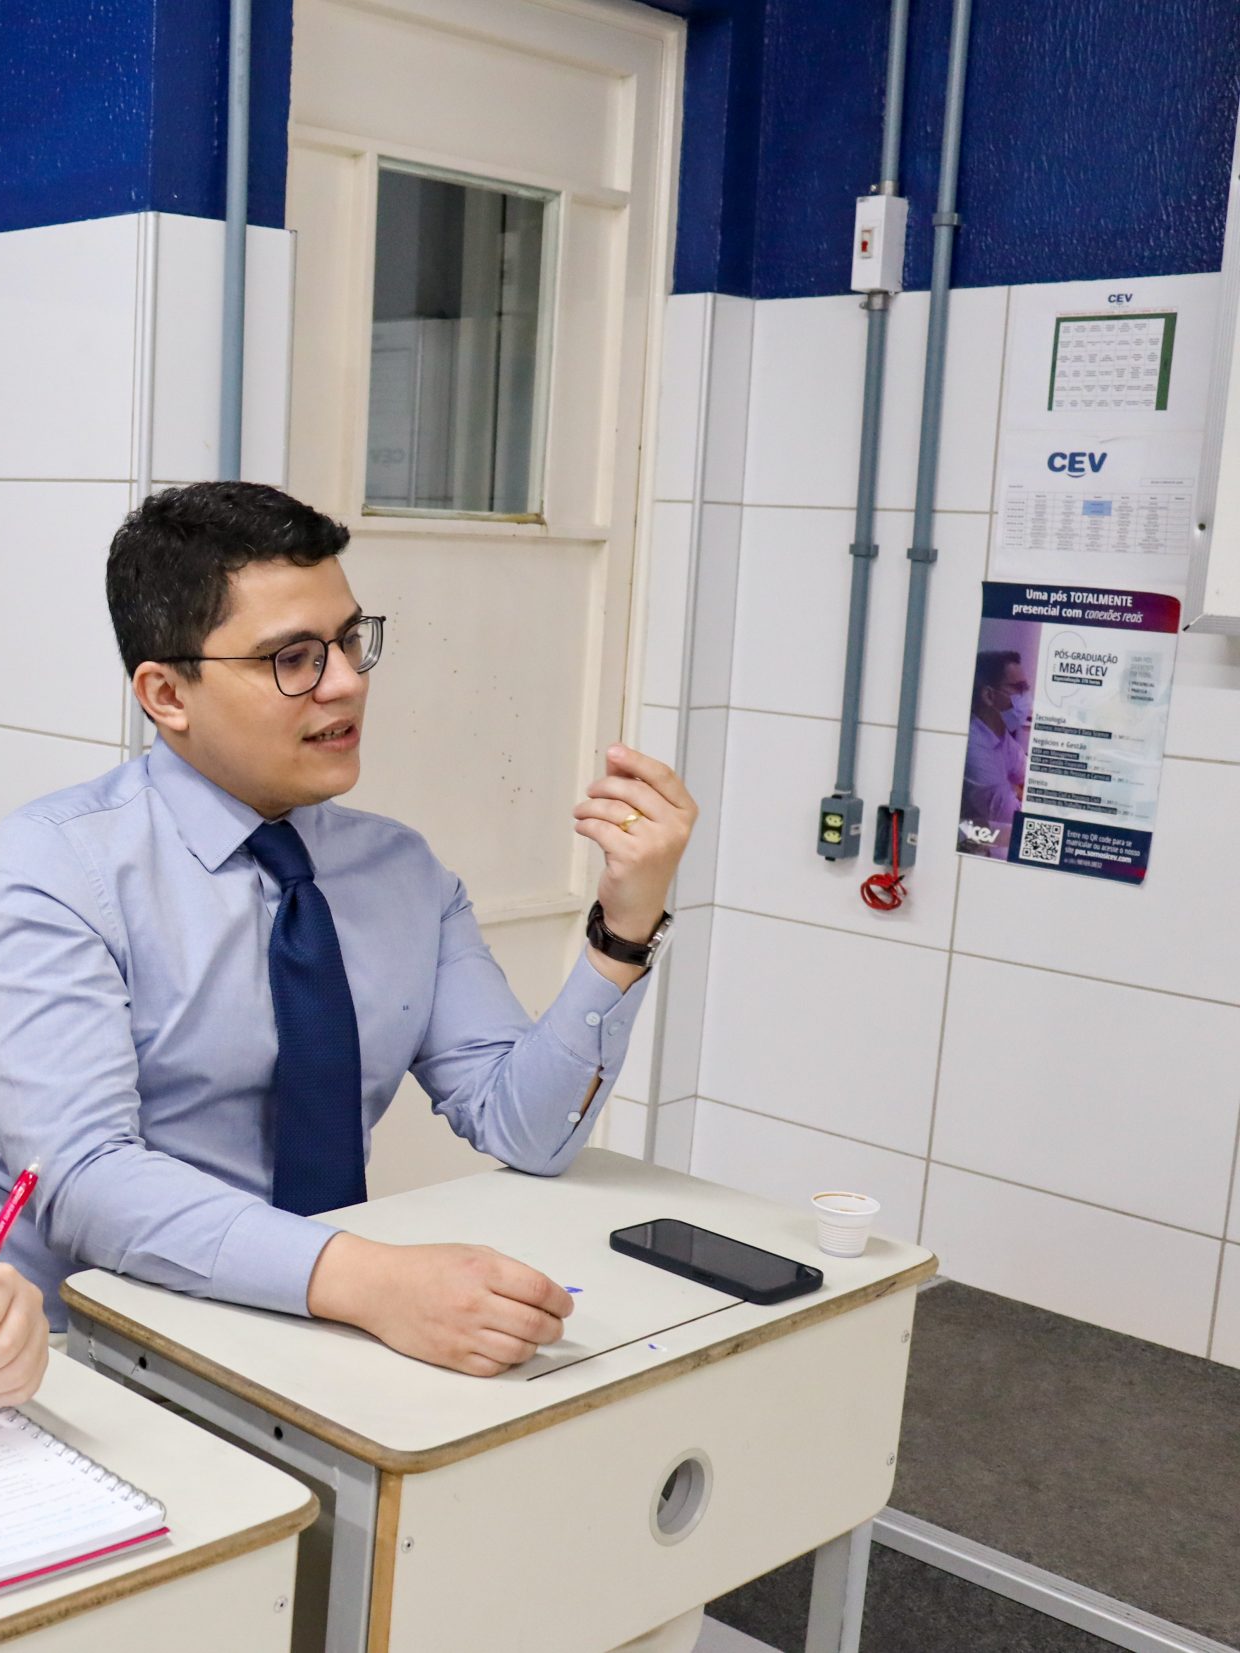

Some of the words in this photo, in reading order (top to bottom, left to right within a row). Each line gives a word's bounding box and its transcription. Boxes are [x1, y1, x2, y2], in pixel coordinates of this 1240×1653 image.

[1108, 293, 1133, 303] CEV
[1047, 452, 1108, 473] CEV
[1026, 588, 1048, 600] Uma
[1050, 590, 1068, 604] pós
[1070, 592, 1132, 607] TOTALMENTE
[1012, 604, 1060, 616] presencial
[1062, 608, 1082, 618] com
[1084, 610, 1121, 622] conexões
[1122, 612, 1143, 623] reais
[1054, 649, 1118, 664] PÓS-GRADUAÇÃO
[1059, 662, 1082, 674] MBA
[1086, 664, 1108, 676] iCEV
[1036, 713, 1066, 724] Tecnologia
[1033, 737, 1058, 748] Negócios
[1066, 740, 1087, 750] Gestão
[1028, 778, 1048, 786] Direito
[1066, 830, 1080, 838] Entre
[1090, 834, 1098, 842] QR
[1099, 836, 1112, 844] code
[1112, 838, 1125, 846] para
[1066, 840, 1092, 848] matricular
[1124, 848, 1140, 856] nosso
